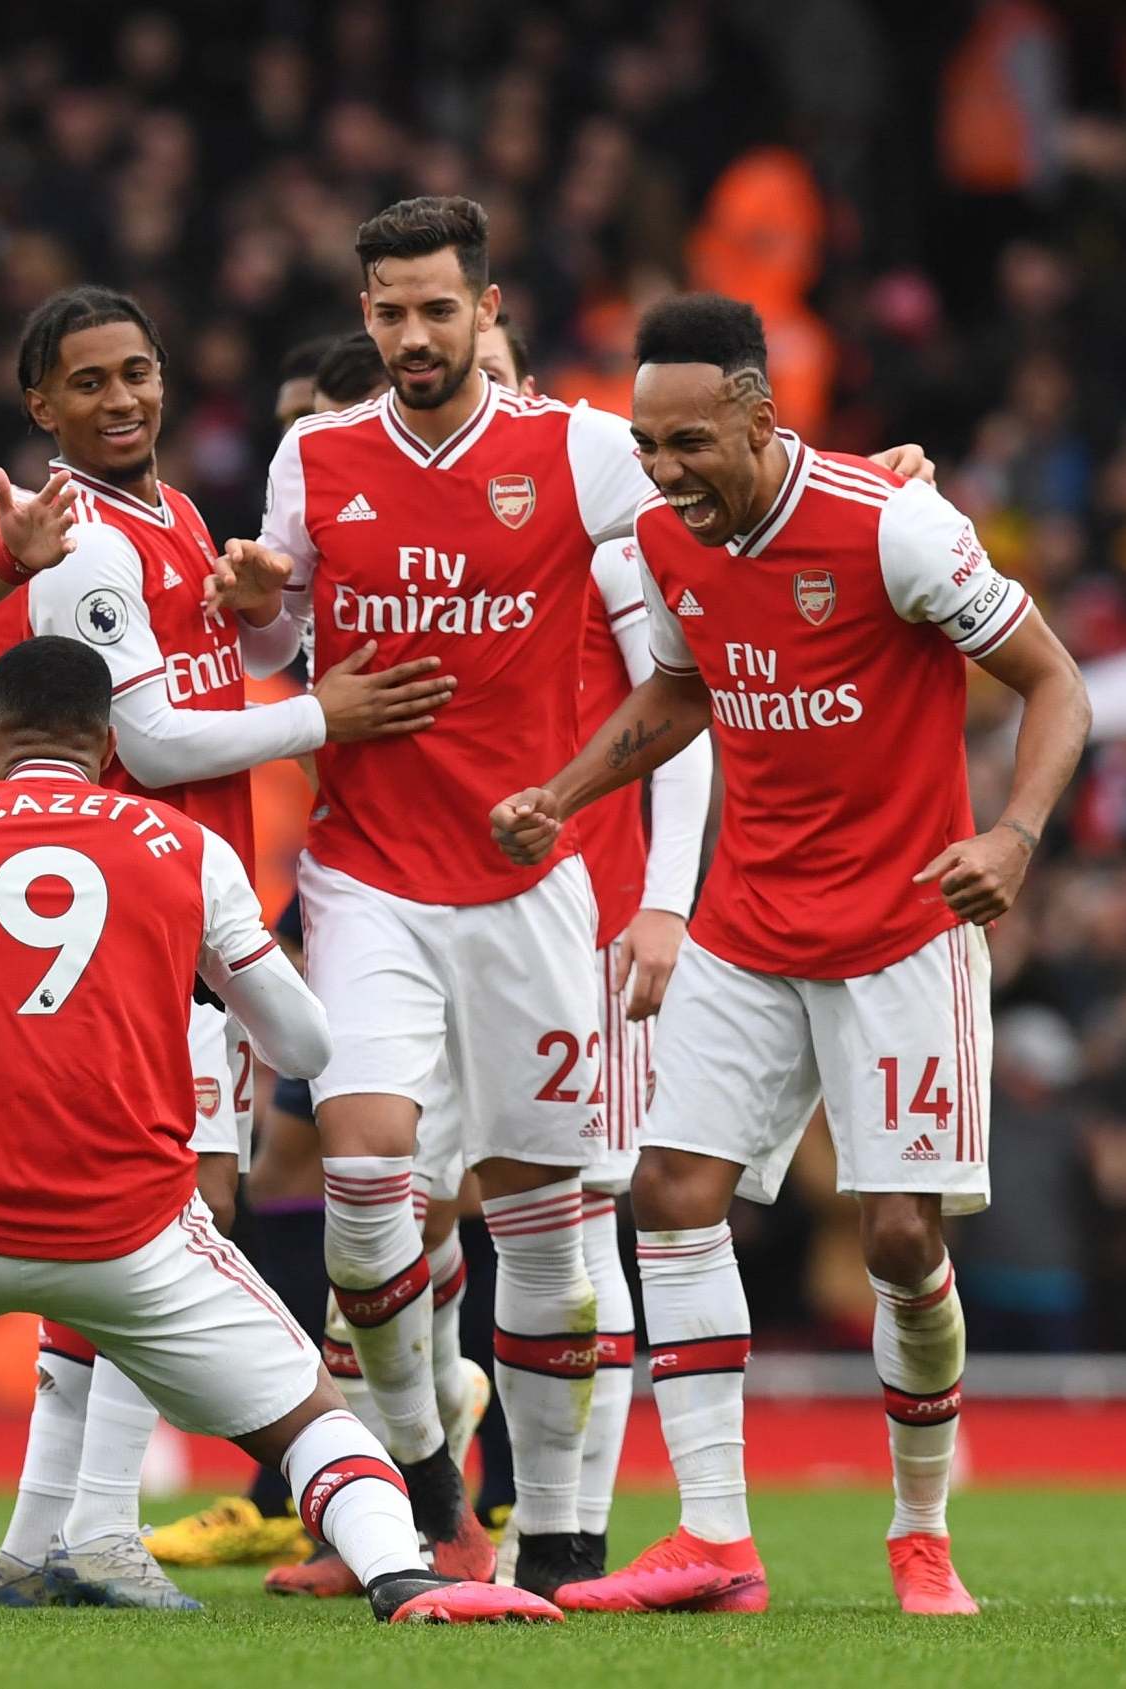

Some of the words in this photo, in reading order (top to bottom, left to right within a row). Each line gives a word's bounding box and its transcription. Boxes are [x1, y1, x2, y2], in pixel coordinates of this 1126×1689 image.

[336, 509, 377, 523] adidas
[398, 546, 467, 588] Fly
[333, 583, 537, 635] Emirates
[725, 643, 777, 684] Fly
[710, 680, 864, 732] mirates
[878, 1056, 954, 1130] 14
[901, 1151, 941, 1161] adidas
